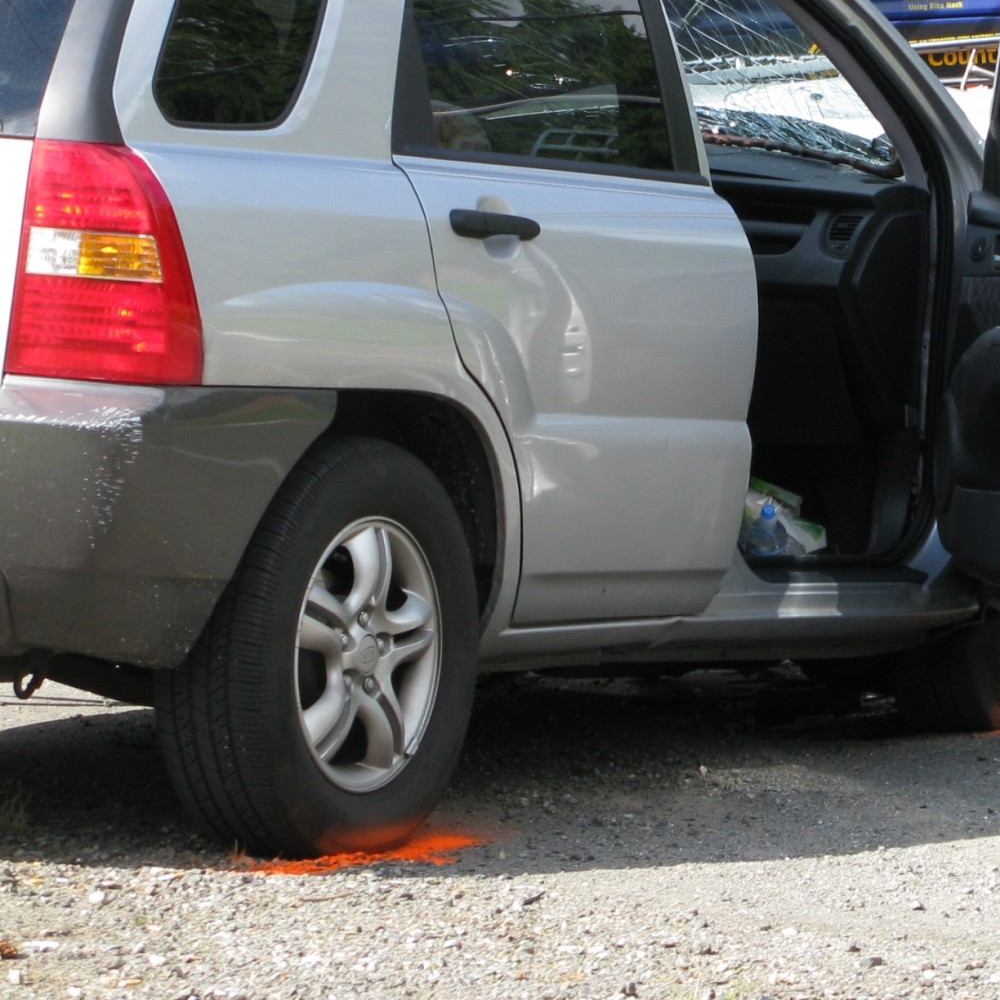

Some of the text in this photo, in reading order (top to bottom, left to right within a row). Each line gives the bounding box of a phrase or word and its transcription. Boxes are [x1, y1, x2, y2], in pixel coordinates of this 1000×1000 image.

[908, 3, 928, 11] Using
[946, 1, 963, 9] Rack
[927, 49, 997, 67] Count
